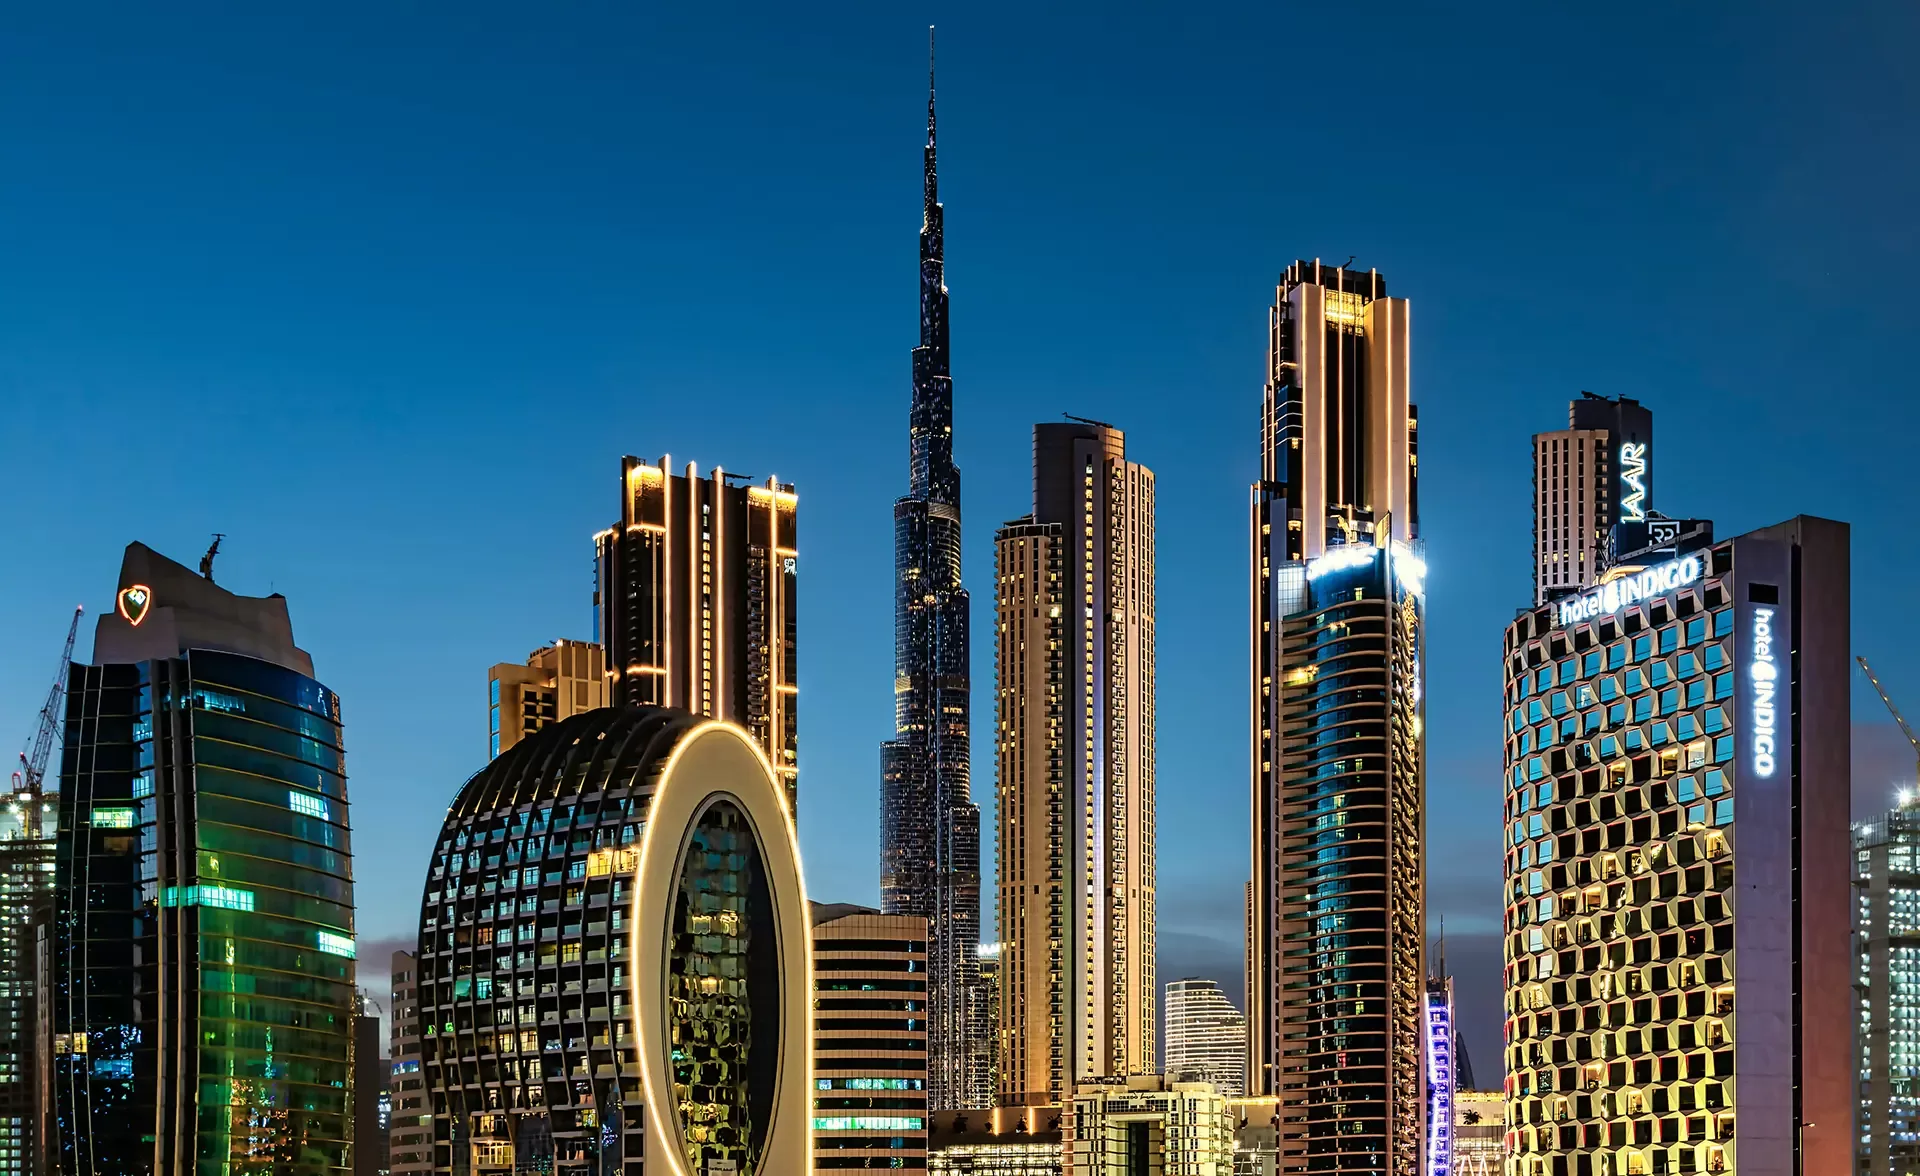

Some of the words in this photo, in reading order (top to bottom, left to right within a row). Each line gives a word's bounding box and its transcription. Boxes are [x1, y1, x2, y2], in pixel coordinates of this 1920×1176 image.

[1560, 587, 1603, 626] hotel
[1621, 557, 1699, 605] INDIGO
[1754, 608, 1774, 661] hotel
[1754, 681, 1775, 777] INDIGO
